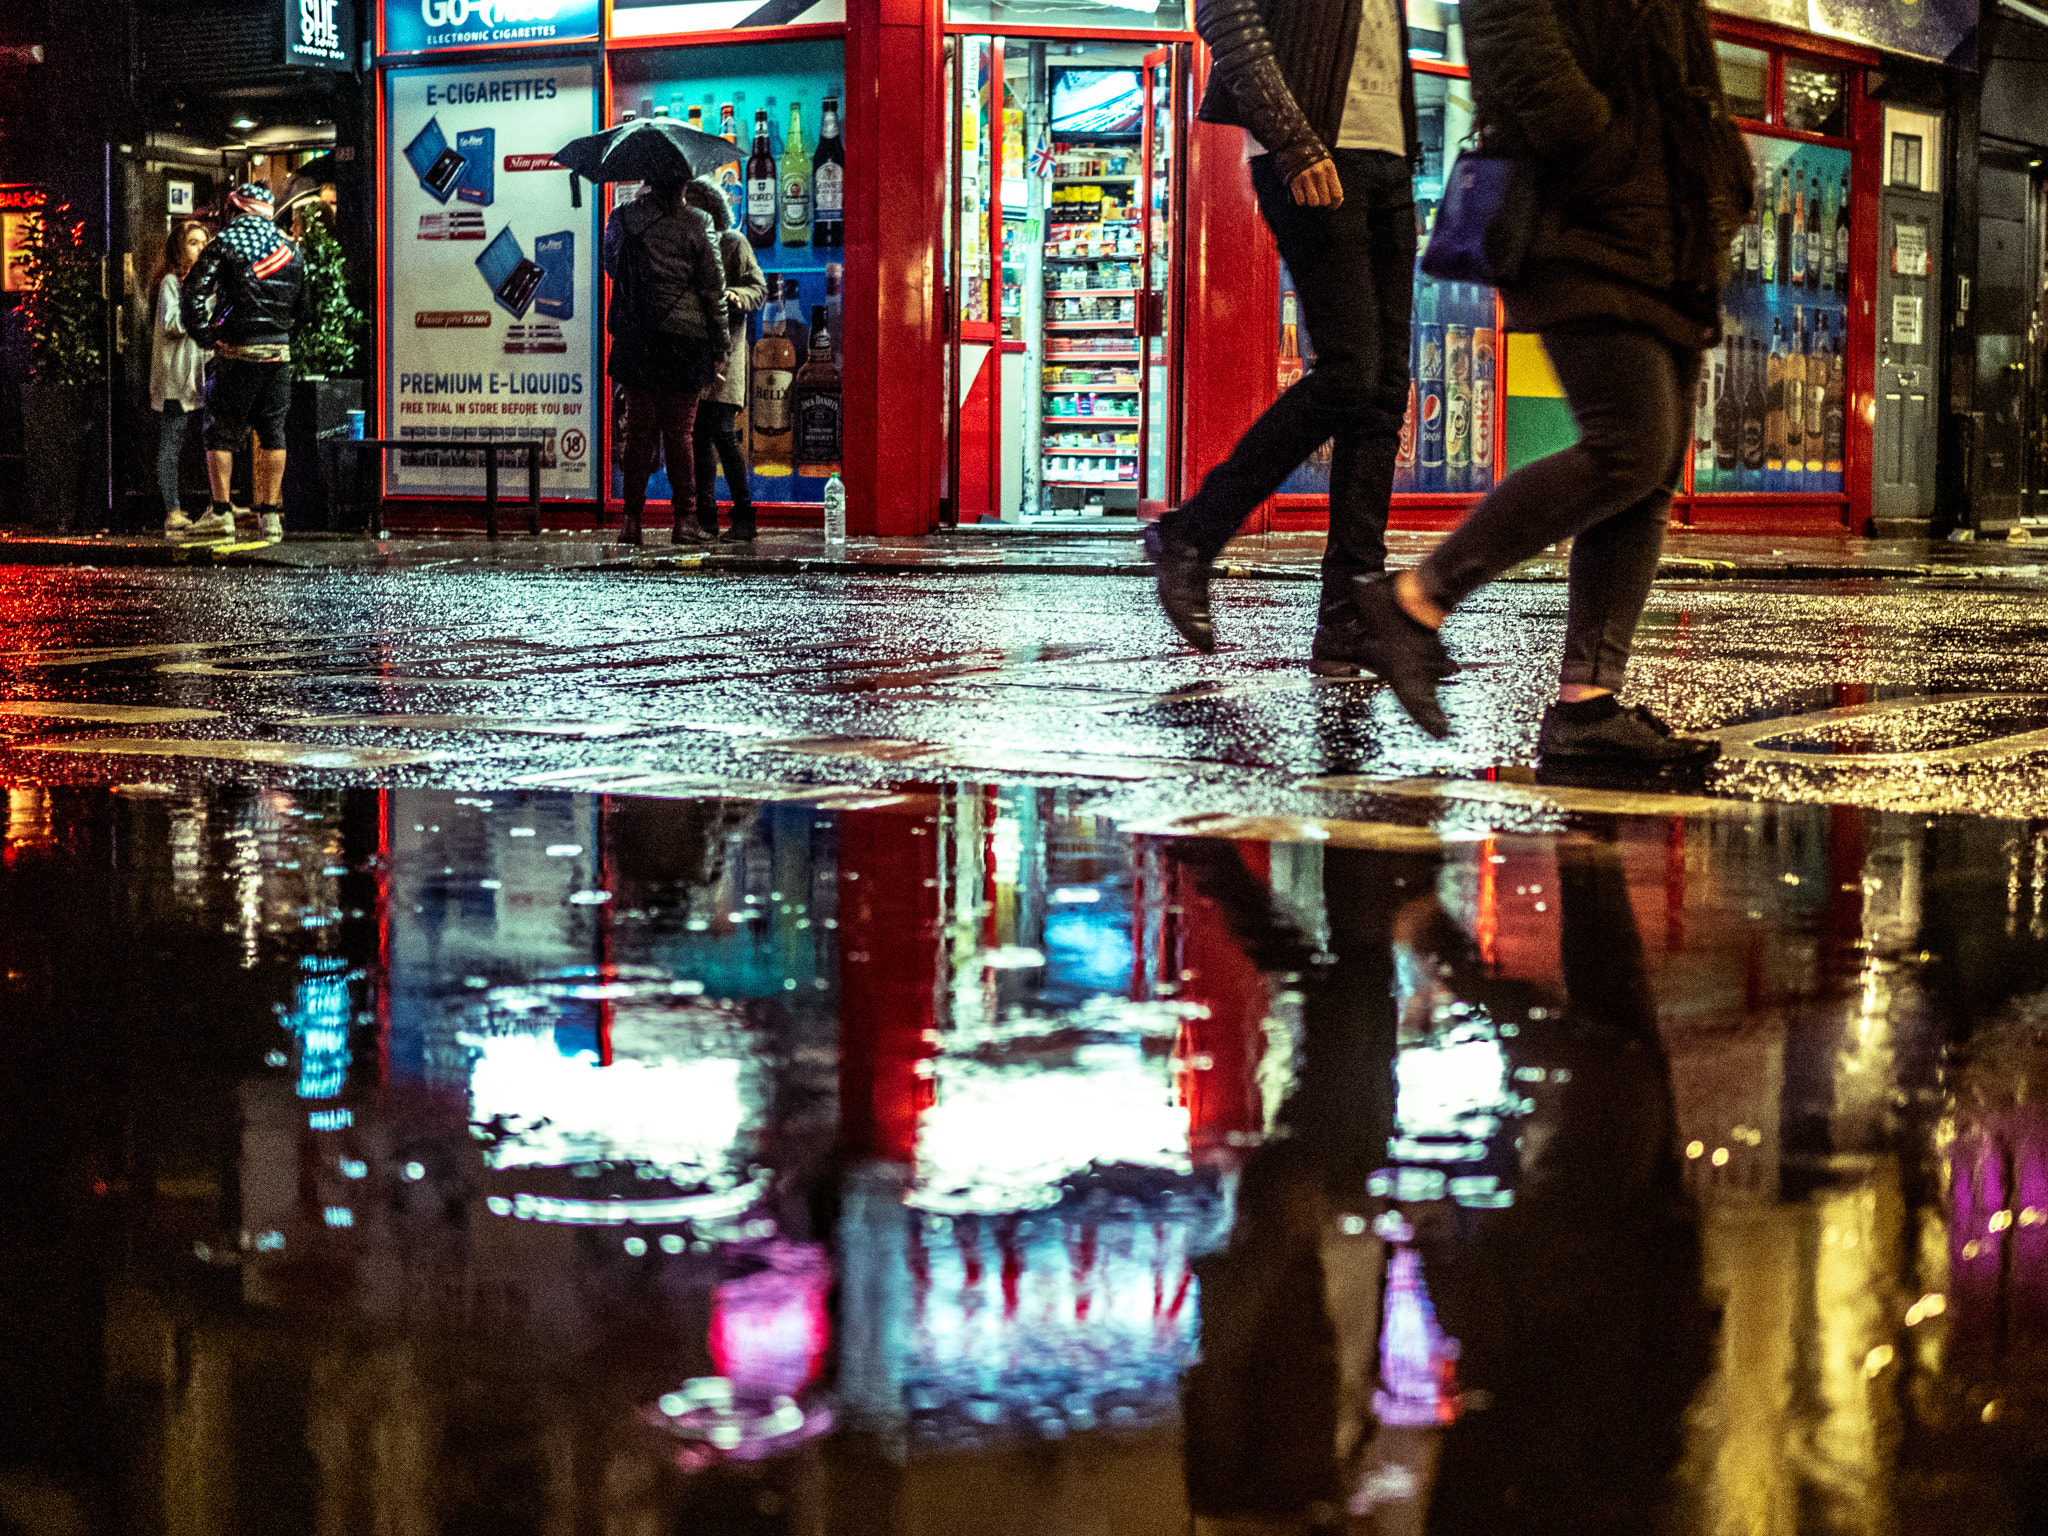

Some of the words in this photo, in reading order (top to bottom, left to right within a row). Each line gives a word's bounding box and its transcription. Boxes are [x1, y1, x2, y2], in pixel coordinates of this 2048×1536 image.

[427, 30, 490, 45] ELECTRONIC
[492, 25, 556, 40] CIGARETTES
[426, 78, 557, 106] E-CIGARETTES
[510, 156, 531, 168] Slim
[530, 159, 548, 171] pro
[400, 372, 482, 395] PREMIUM
[489, 372, 583, 395] E-LIQUIDS
[400, 402, 424, 414] FREE
[425, 402, 452, 415] TRIAL
[455, 403, 466, 414] IN
[468, 402, 499, 415] STORE
[501, 402, 538, 415] BEFORE
[541, 403, 561, 415] YOU
[563, 403, 583, 416] BUY
[566, 436, 581, 453] 18
